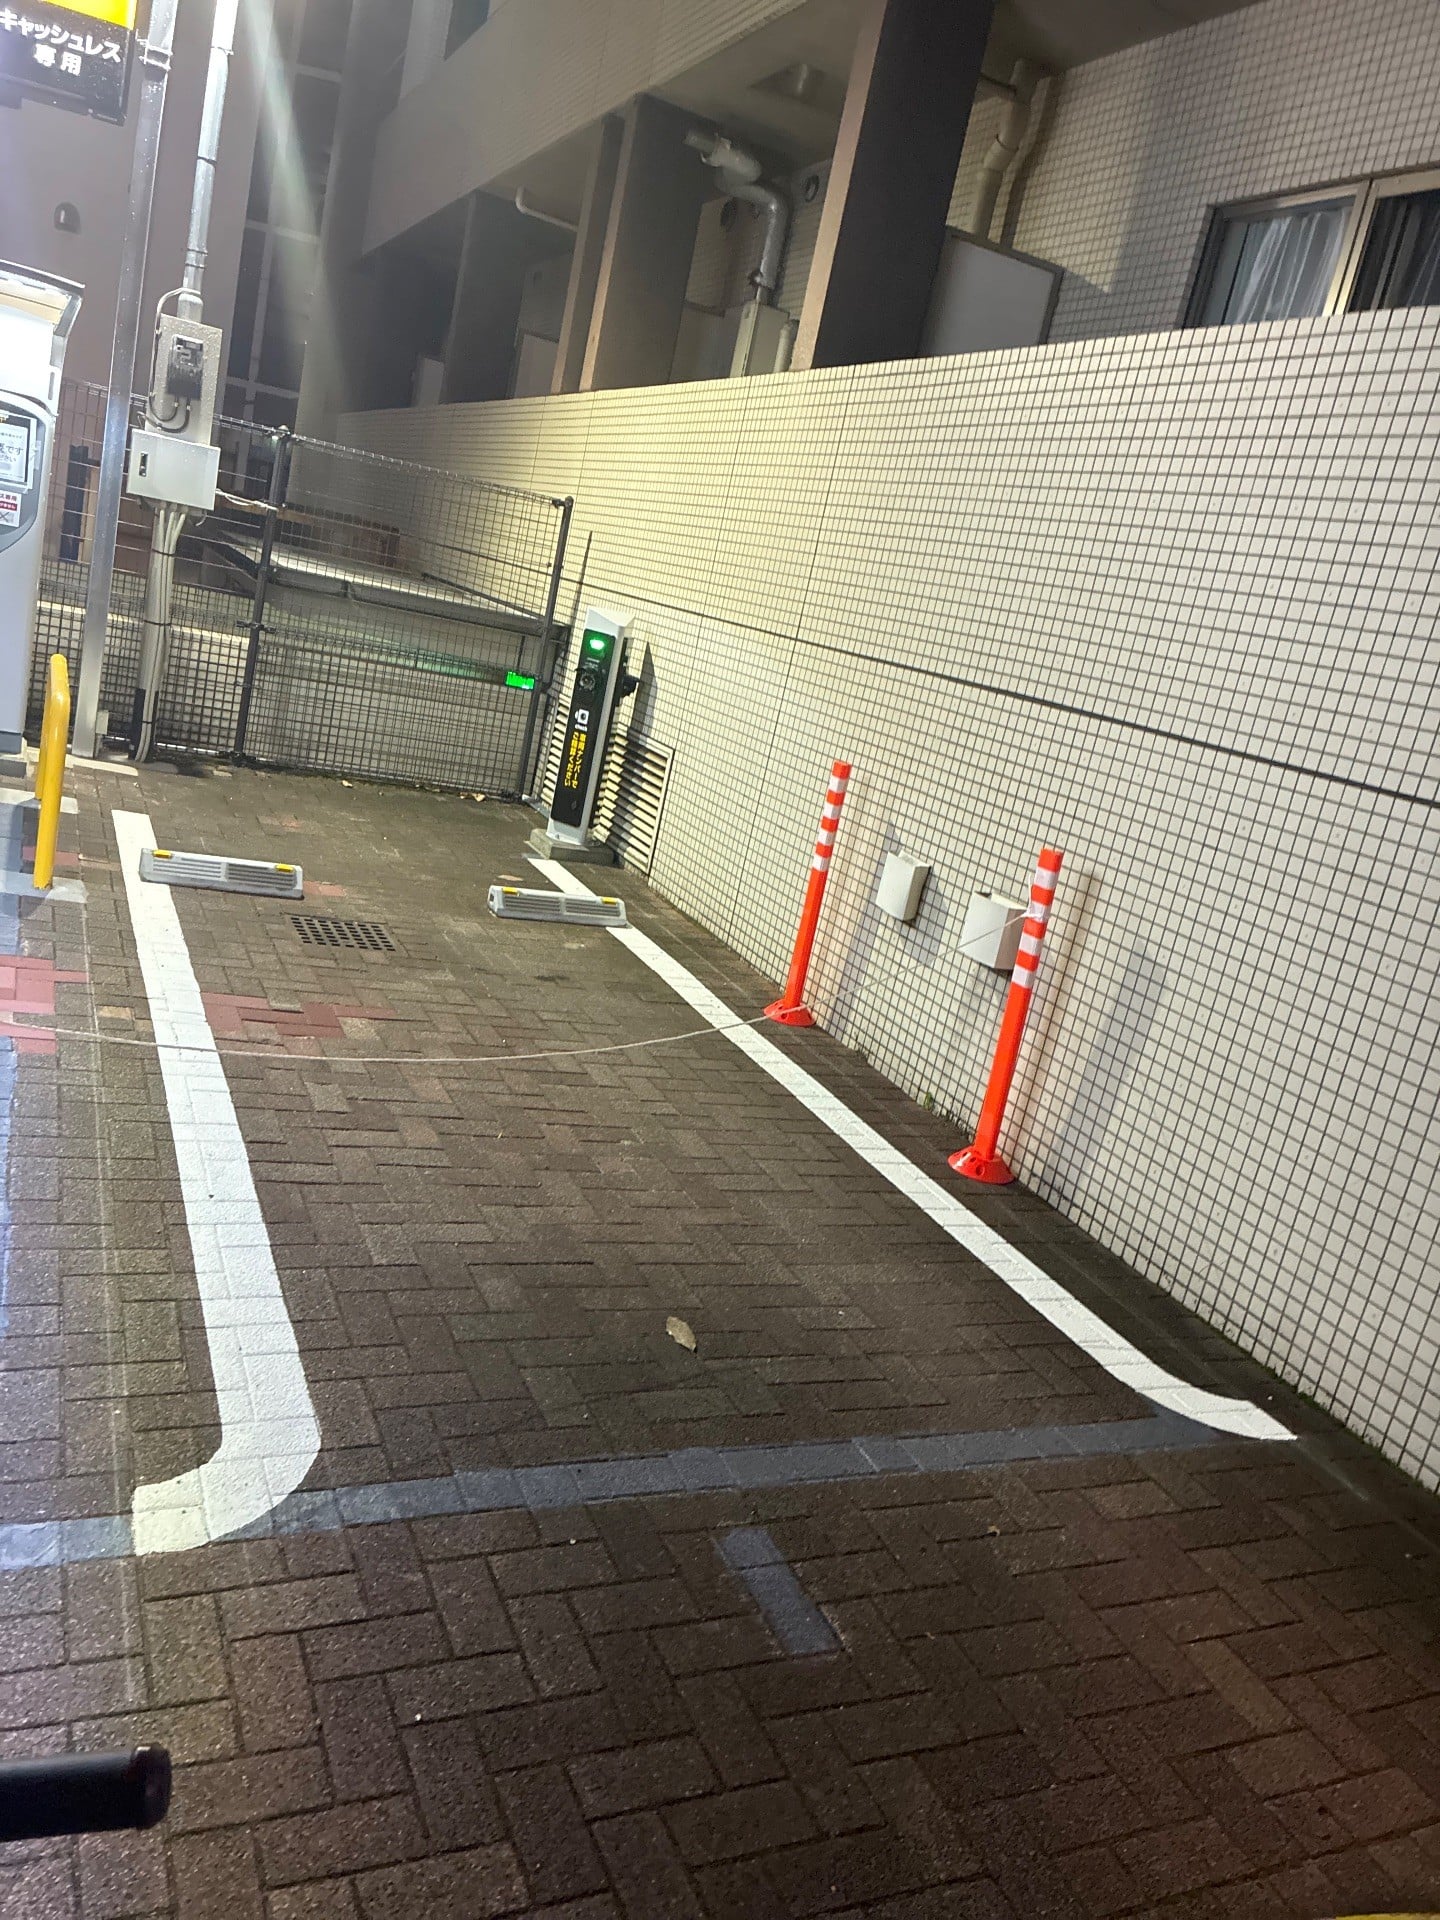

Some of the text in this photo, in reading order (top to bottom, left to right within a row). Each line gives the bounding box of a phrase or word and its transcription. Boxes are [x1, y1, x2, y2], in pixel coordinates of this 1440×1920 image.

[0, 8, 121, 63] キャッシュレス
[33, 43, 82, 76] 専用
